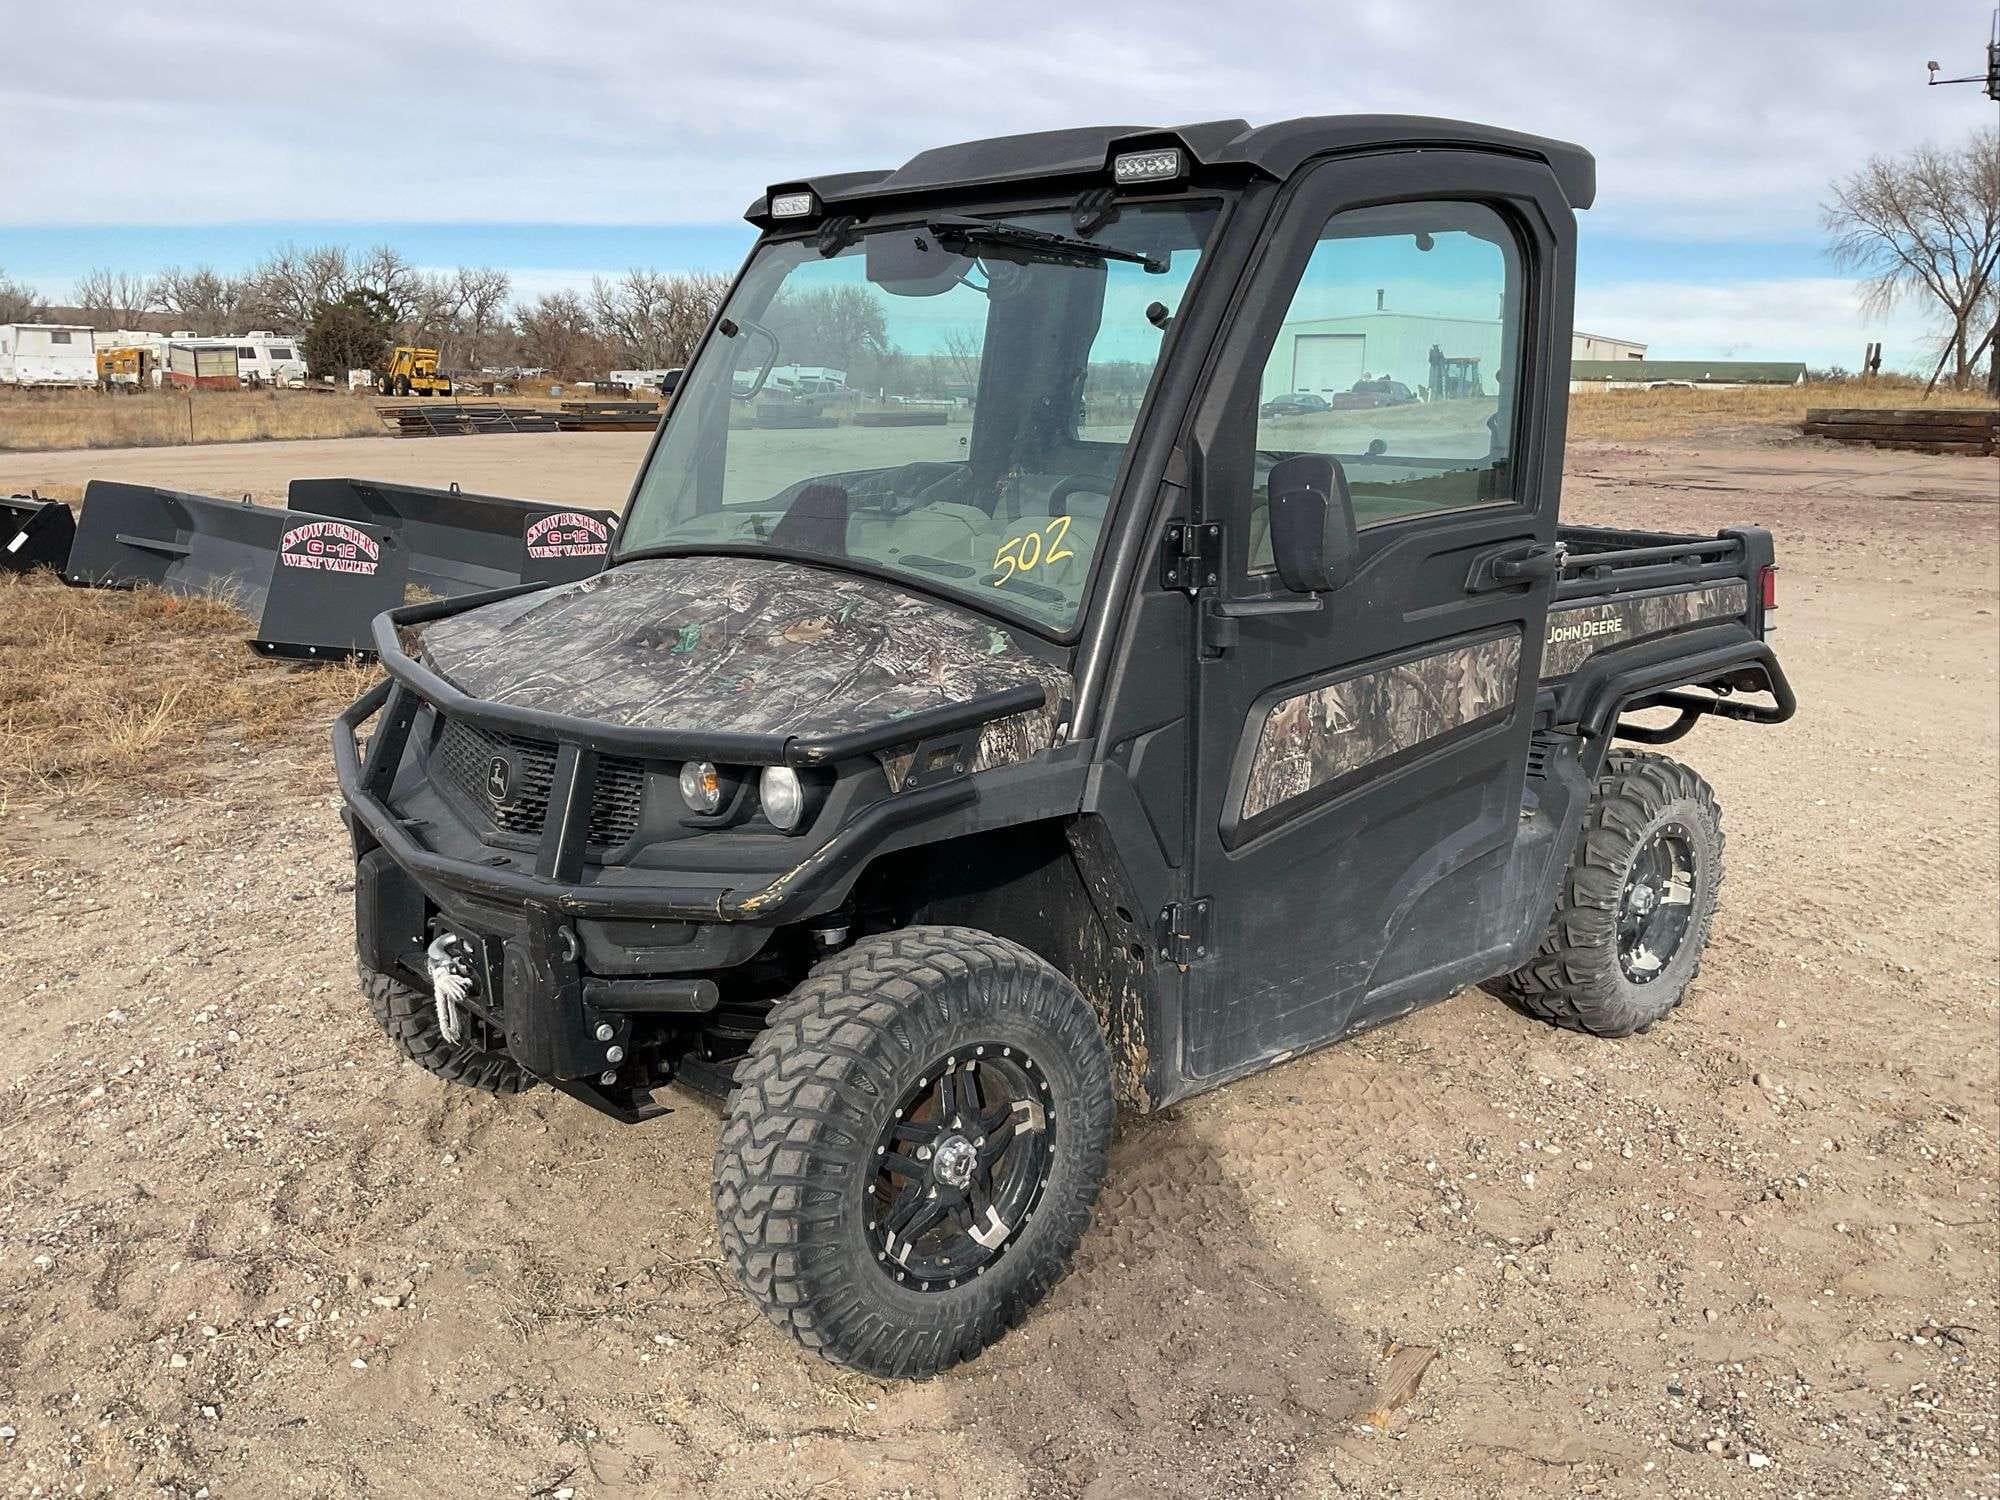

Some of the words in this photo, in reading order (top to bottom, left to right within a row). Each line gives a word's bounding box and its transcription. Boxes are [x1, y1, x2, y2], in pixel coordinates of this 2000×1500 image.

[282, 522, 325, 552] SNOW
[324, 521, 379, 561] BUSTERS
[527, 513, 560, 546] SNOW
[560, 512, 608, 541] BUSTERS
[281, 552, 323, 570] WEST
[323, 557, 379, 575] VALLEY
[527, 546, 562, 558] WEST
[562, 543, 608, 557] VALLEY
[992, 515, 1074, 587] 502
[1547, 624, 1581, 644] JOHN
[1582, 618, 1623, 638] DEERE
